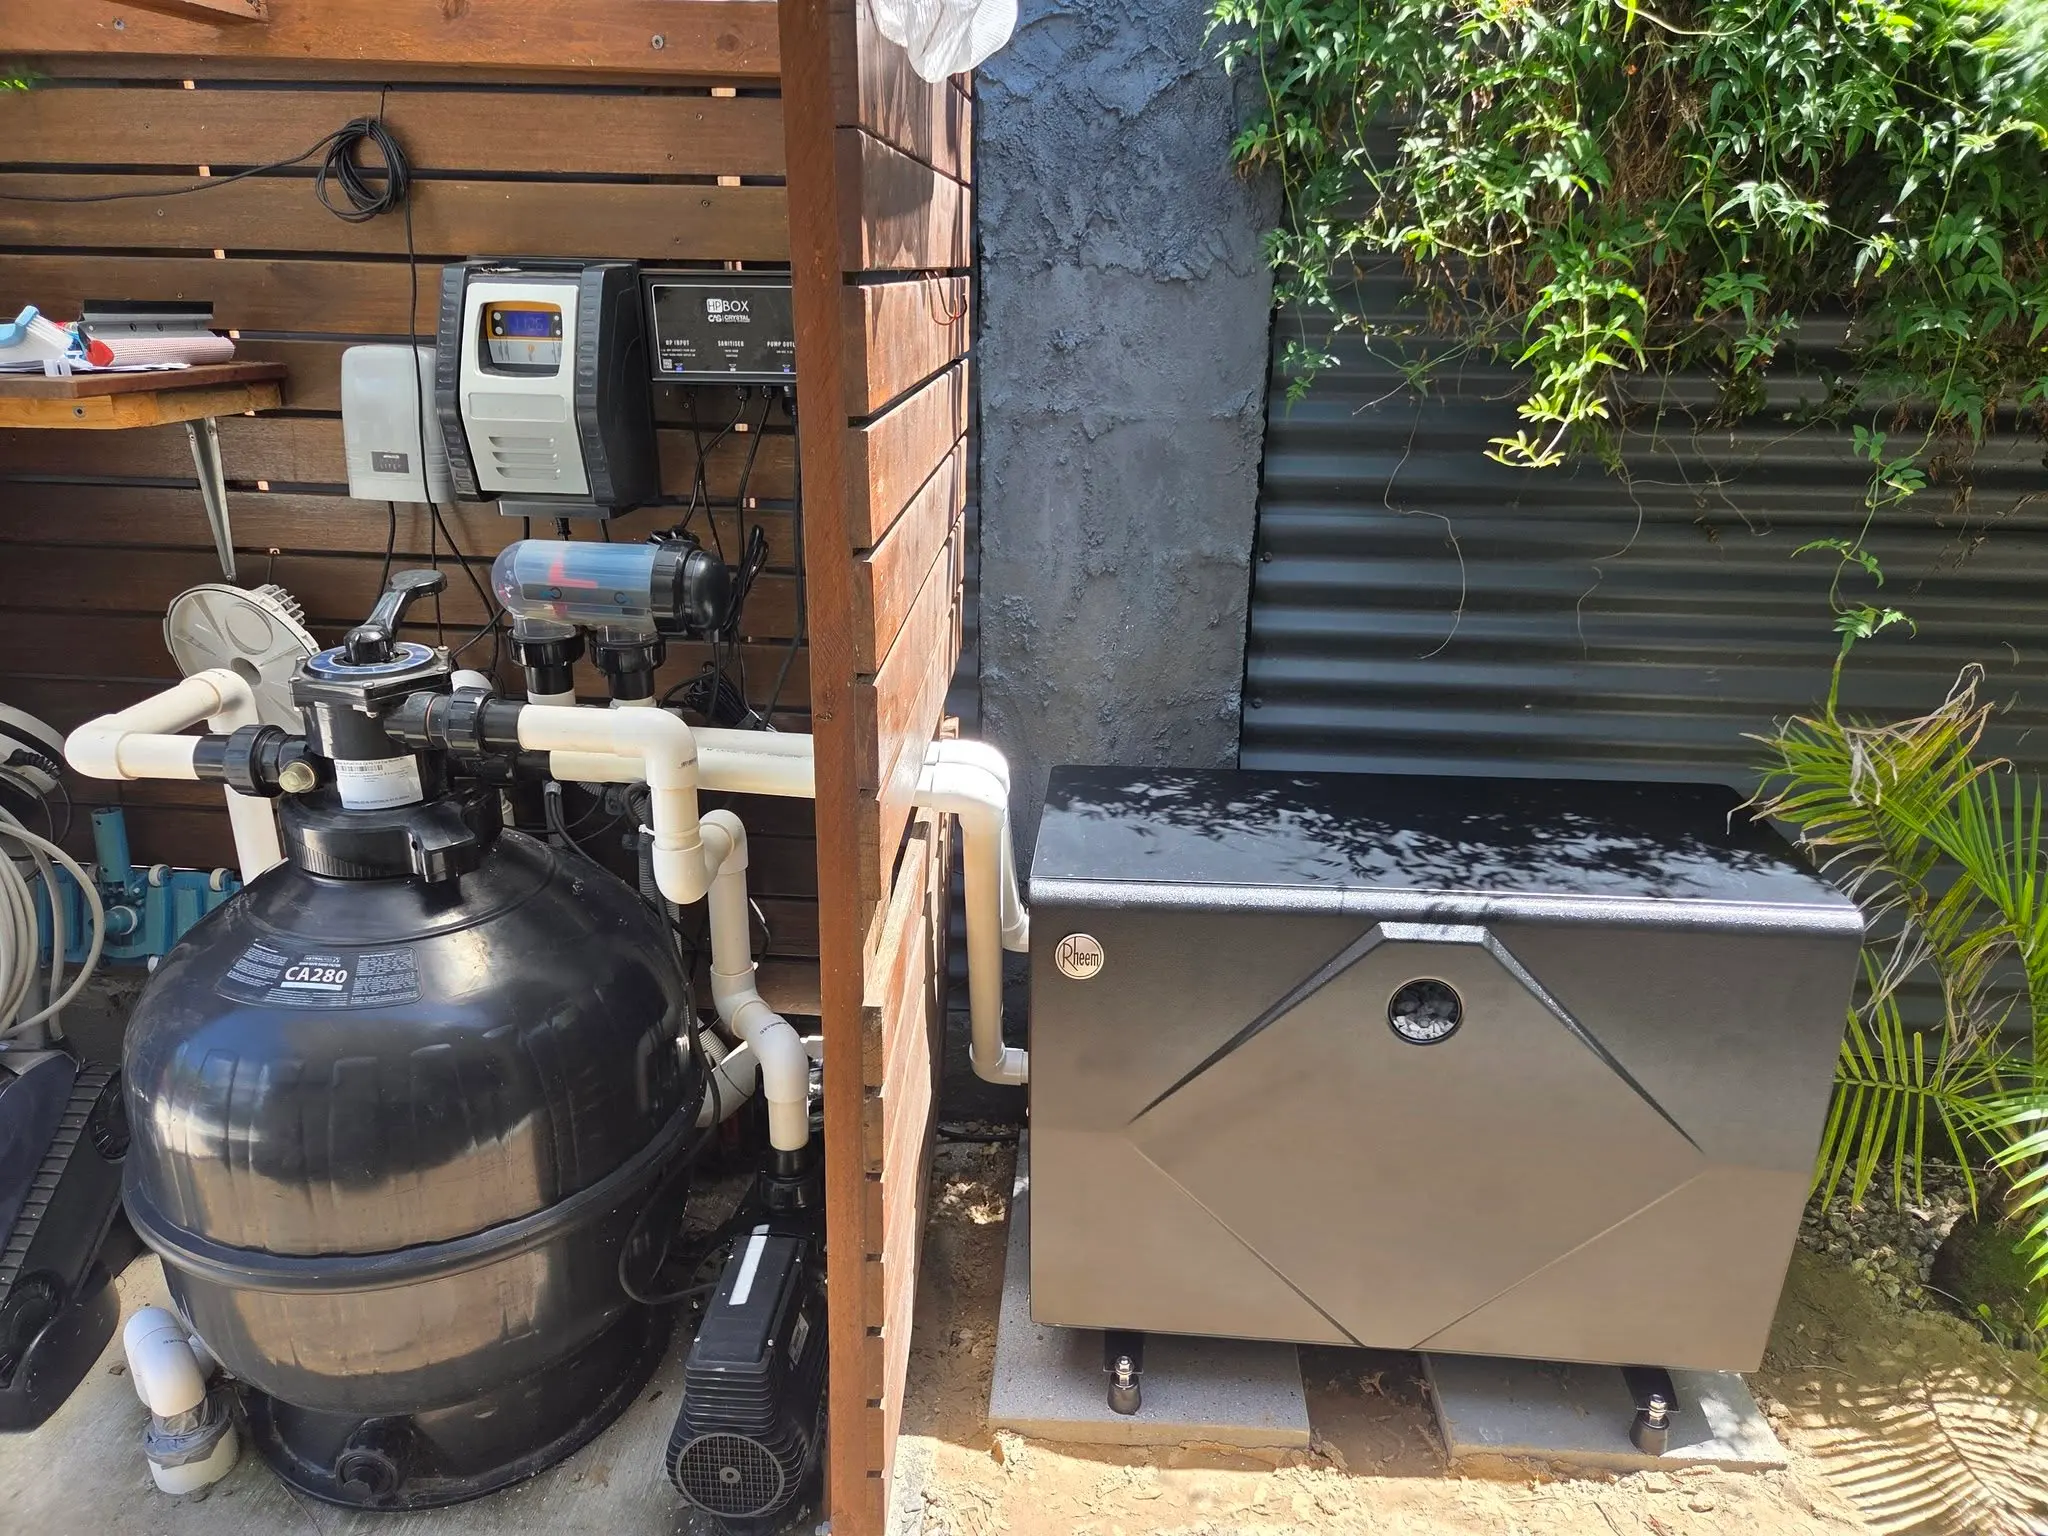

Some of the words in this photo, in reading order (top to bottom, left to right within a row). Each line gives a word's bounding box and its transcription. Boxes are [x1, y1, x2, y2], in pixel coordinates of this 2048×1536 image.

[674, 339, 690, 347] INPUT
[766, 340, 782, 348] PUMP
[1062, 936, 1099, 971] Rheem
[284, 966, 348, 984] CA280
